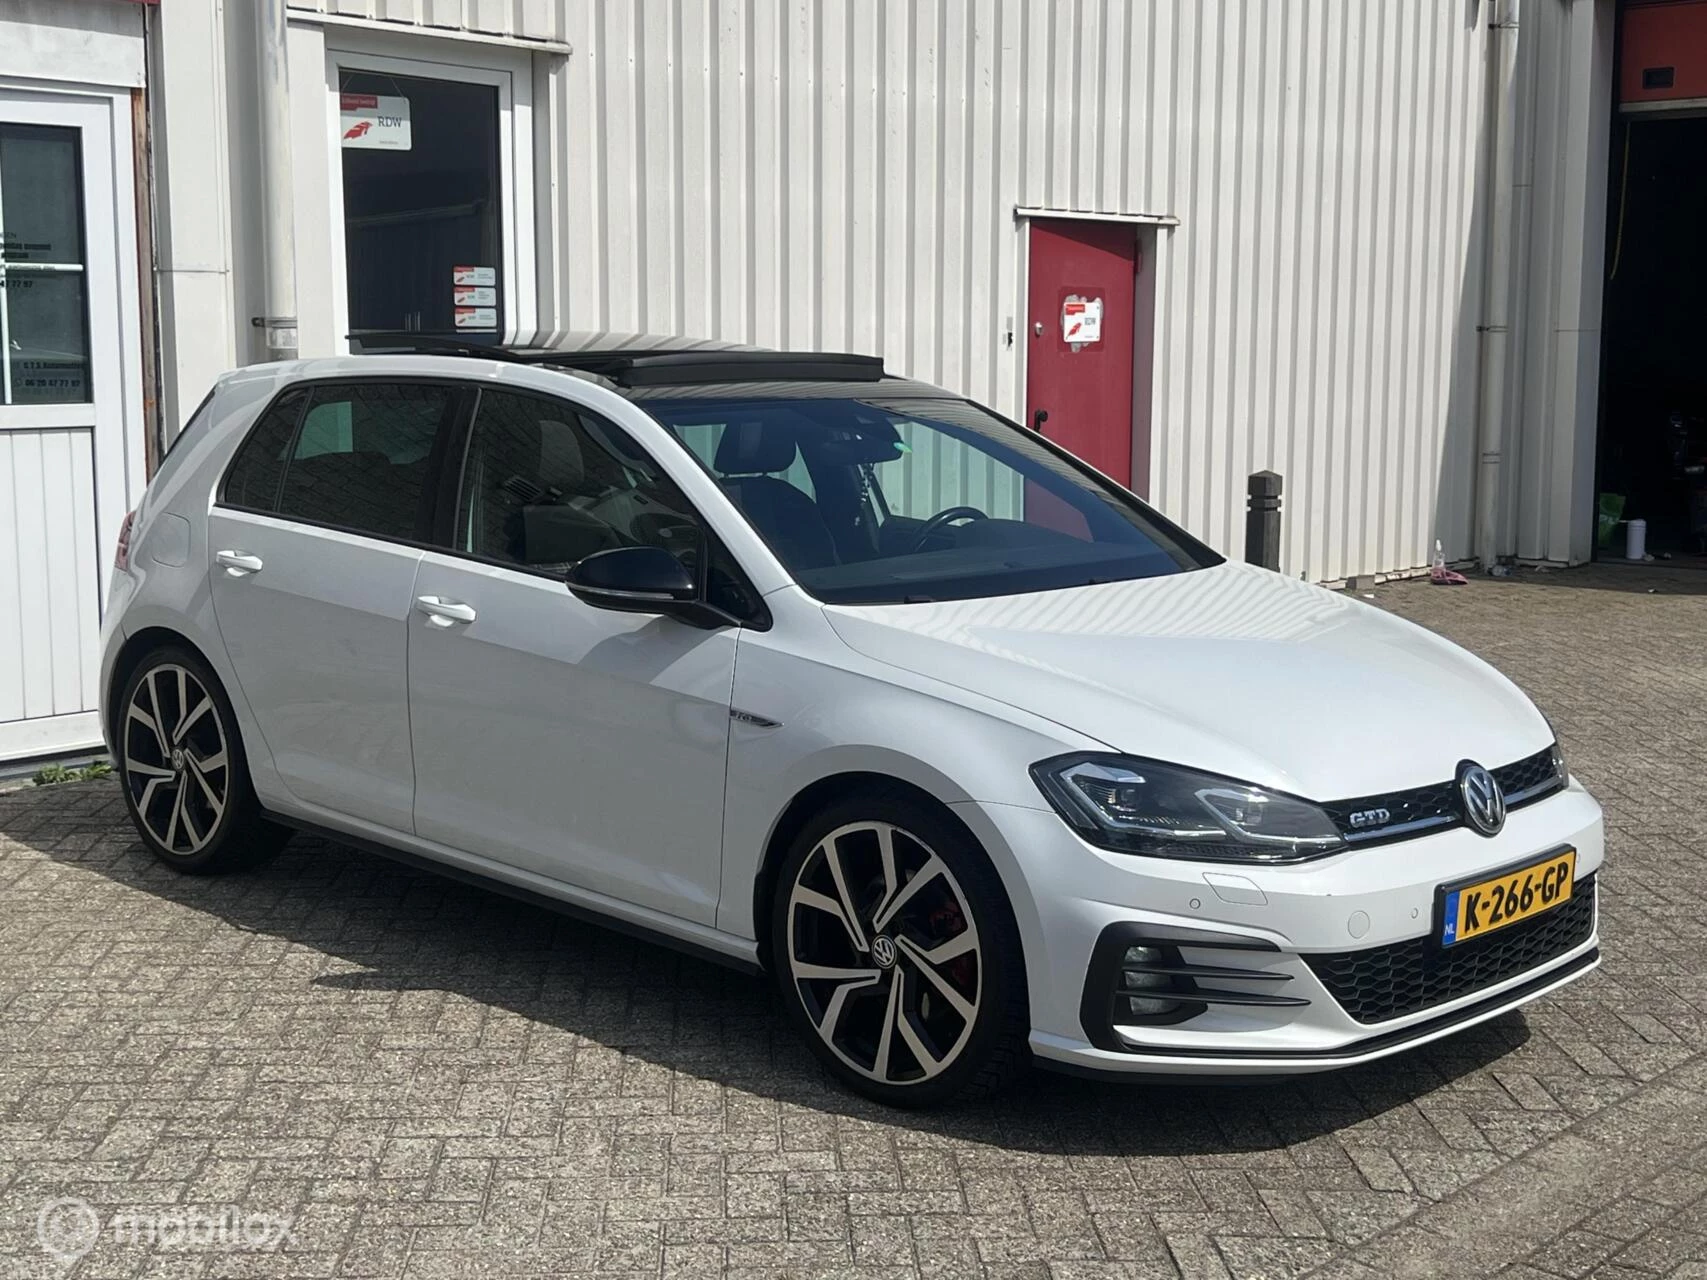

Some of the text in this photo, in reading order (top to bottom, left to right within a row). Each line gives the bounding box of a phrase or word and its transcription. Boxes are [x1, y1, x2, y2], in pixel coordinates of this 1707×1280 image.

[377, 116, 402, 128] RDW
[1349, 808, 1391, 828] GTD
[1463, 861, 1569, 934] K-266-GP
[1444, 924, 1455, 936] NL
